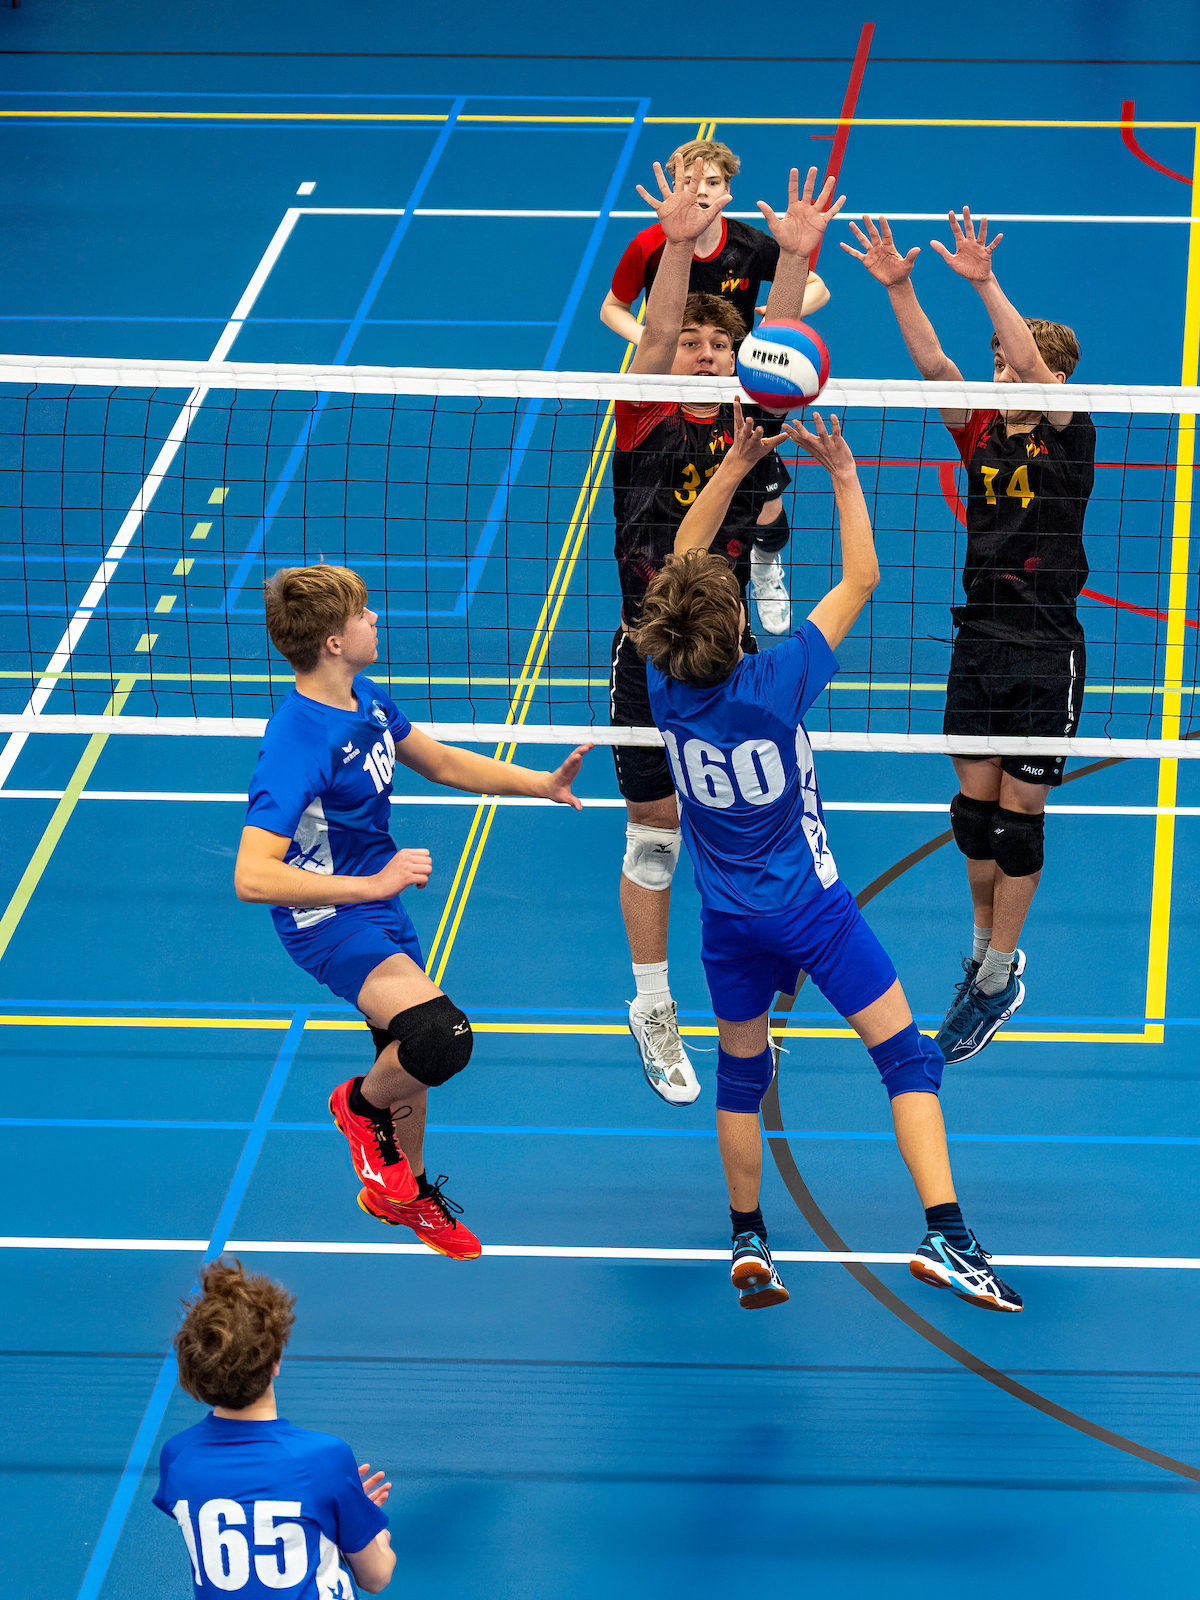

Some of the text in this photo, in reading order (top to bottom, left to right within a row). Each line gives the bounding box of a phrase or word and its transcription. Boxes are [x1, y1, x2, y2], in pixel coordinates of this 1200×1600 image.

[363, 728, 396, 795] 164
[660, 730, 786, 808] 160
[1021, 764, 1045, 776] JAKO
[172, 1498, 308, 1591] 165
